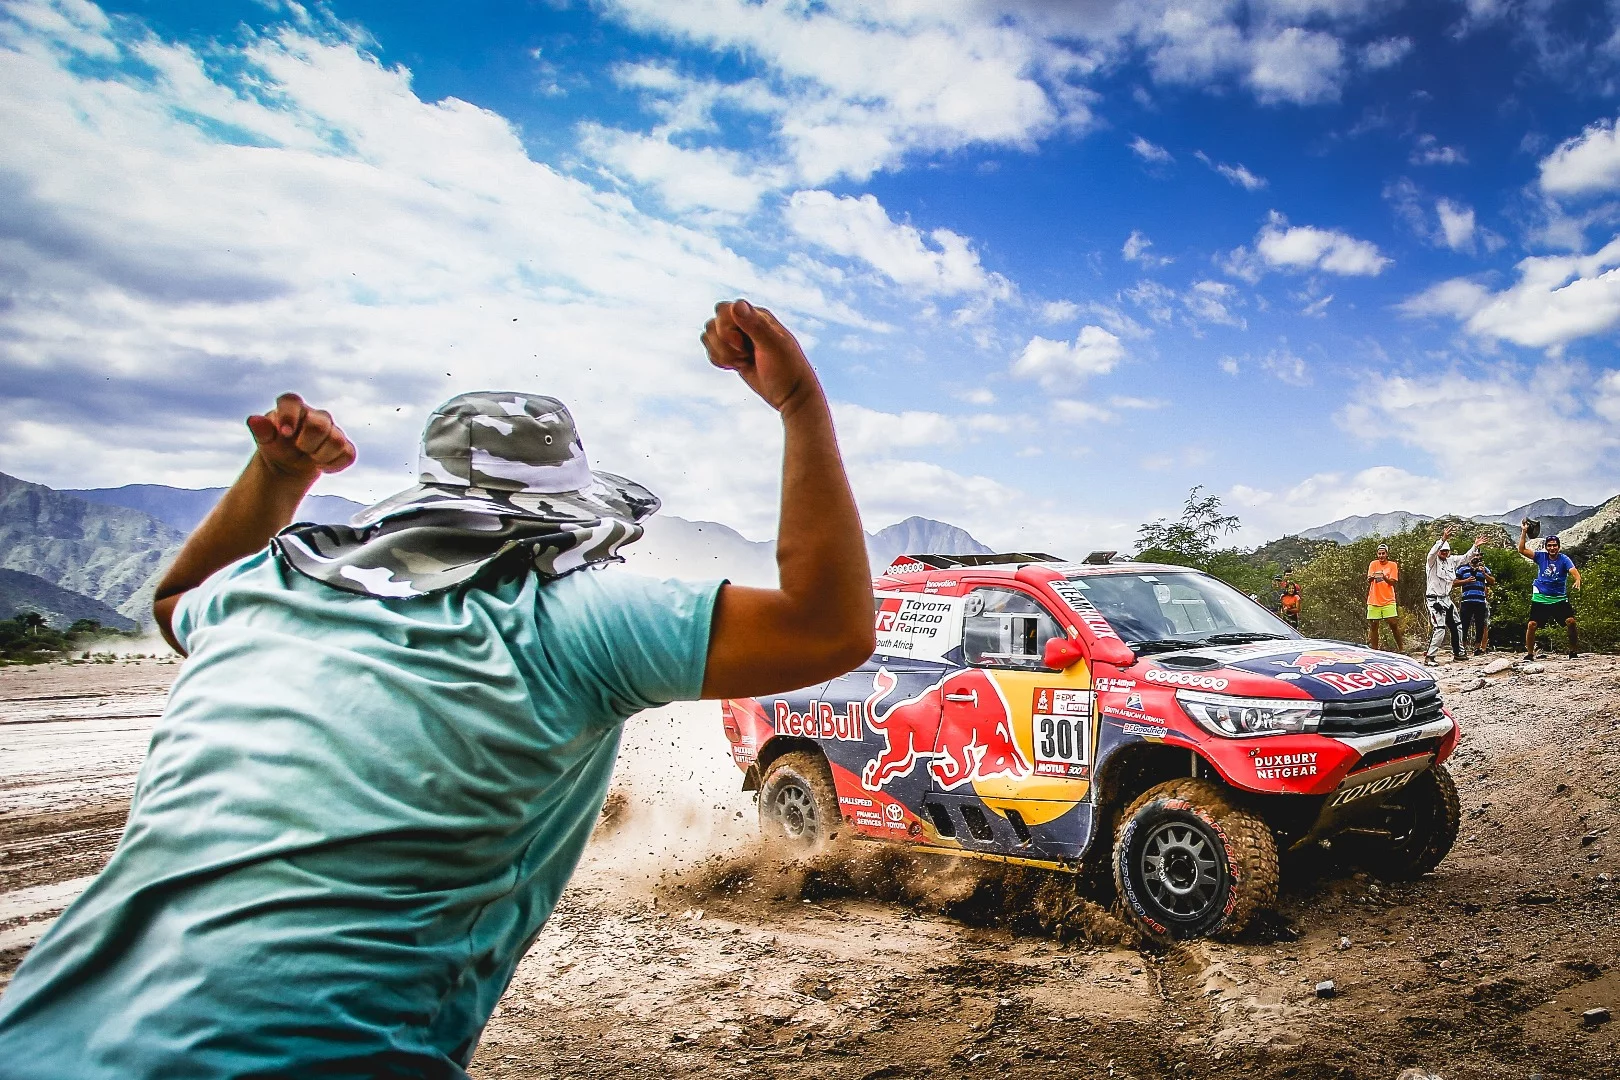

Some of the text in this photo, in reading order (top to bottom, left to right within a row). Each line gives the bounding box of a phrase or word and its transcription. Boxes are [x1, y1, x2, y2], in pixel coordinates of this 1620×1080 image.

[906, 600, 951, 612] TOYOTA
[900, 612, 942, 624] GAZOO
[895, 623, 938, 638] Racing
[892, 640, 914, 650] Africa
[1145, 670, 1228, 690] ooredoo
[1311, 663, 1397, 694] Red
[1041, 718, 1083, 760] 301
[1255, 753, 1318, 767] DUXBURY
[1038, 763, 1066, 774] MOTUL
[1257, 767, 1317, 779] NETGEAR
[1331, 771, 1414, 807] TOYOTA
[840, 797, 873, 806] HALLSPEED
[886, 821, 906, 830] TOYOTA
